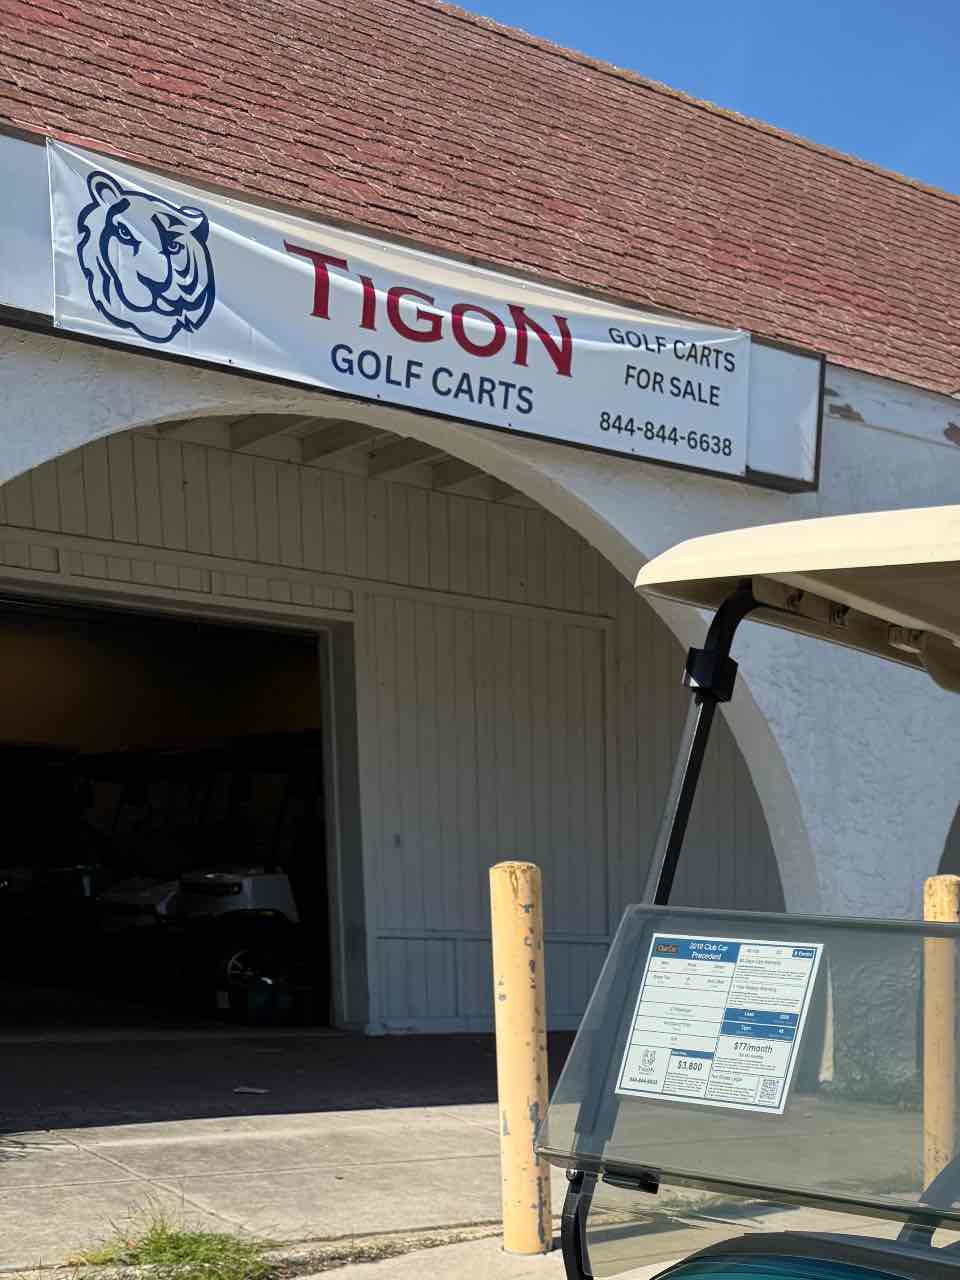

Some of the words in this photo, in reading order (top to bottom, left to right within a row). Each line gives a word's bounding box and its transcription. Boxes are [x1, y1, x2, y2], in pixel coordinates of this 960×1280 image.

[283, 240, 574, 378] TIGON
[608, 327, 667, 354] GOLF
[673, 339, 736, 373] CARTS
[330, 343, 424, 389] GOLF
[431, 366, 534, 415] CARTS
[624, 364, 665, 395] FOR
[669, 376, 721, 407] SALE
[599, 411, 733, 457] 844-844-6638
[733, 1041, 774, 1055] $77/month
